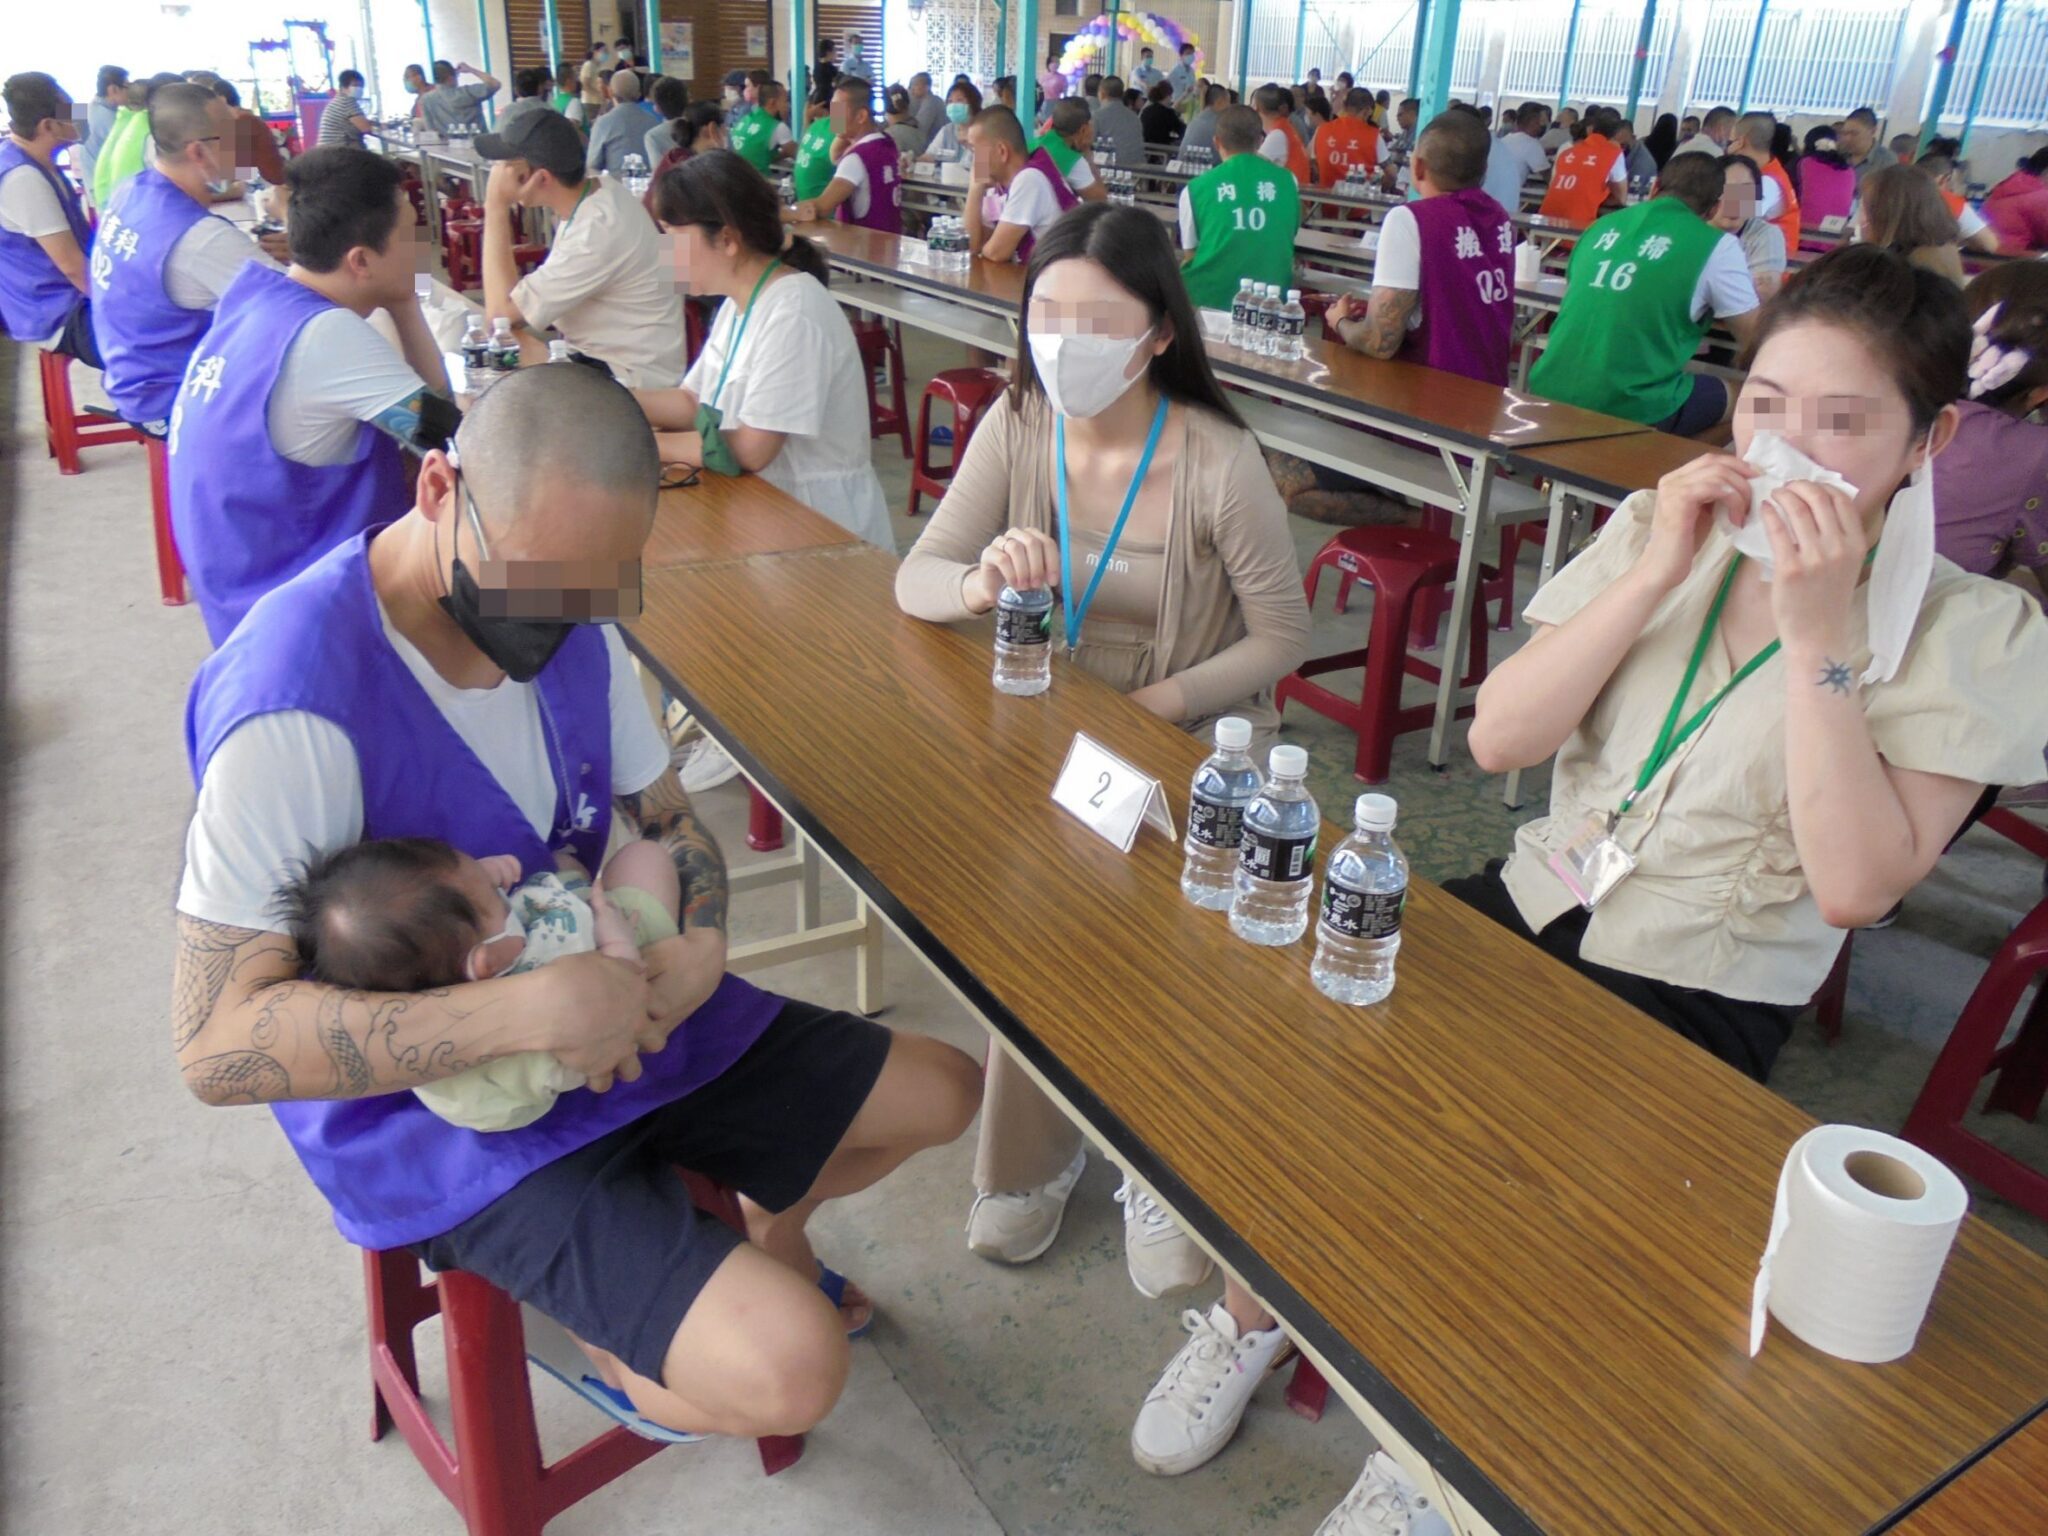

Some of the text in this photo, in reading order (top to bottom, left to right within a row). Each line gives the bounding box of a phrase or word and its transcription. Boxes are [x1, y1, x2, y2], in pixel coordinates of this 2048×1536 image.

[1555, 174, 1577, 190] 10
[1231, 207, 1266, 231] 10
[1475, 268, 1508, 304] 03
[1588, 259, 1638, 291] 16
[1088, 771, 1112, 809] 2
